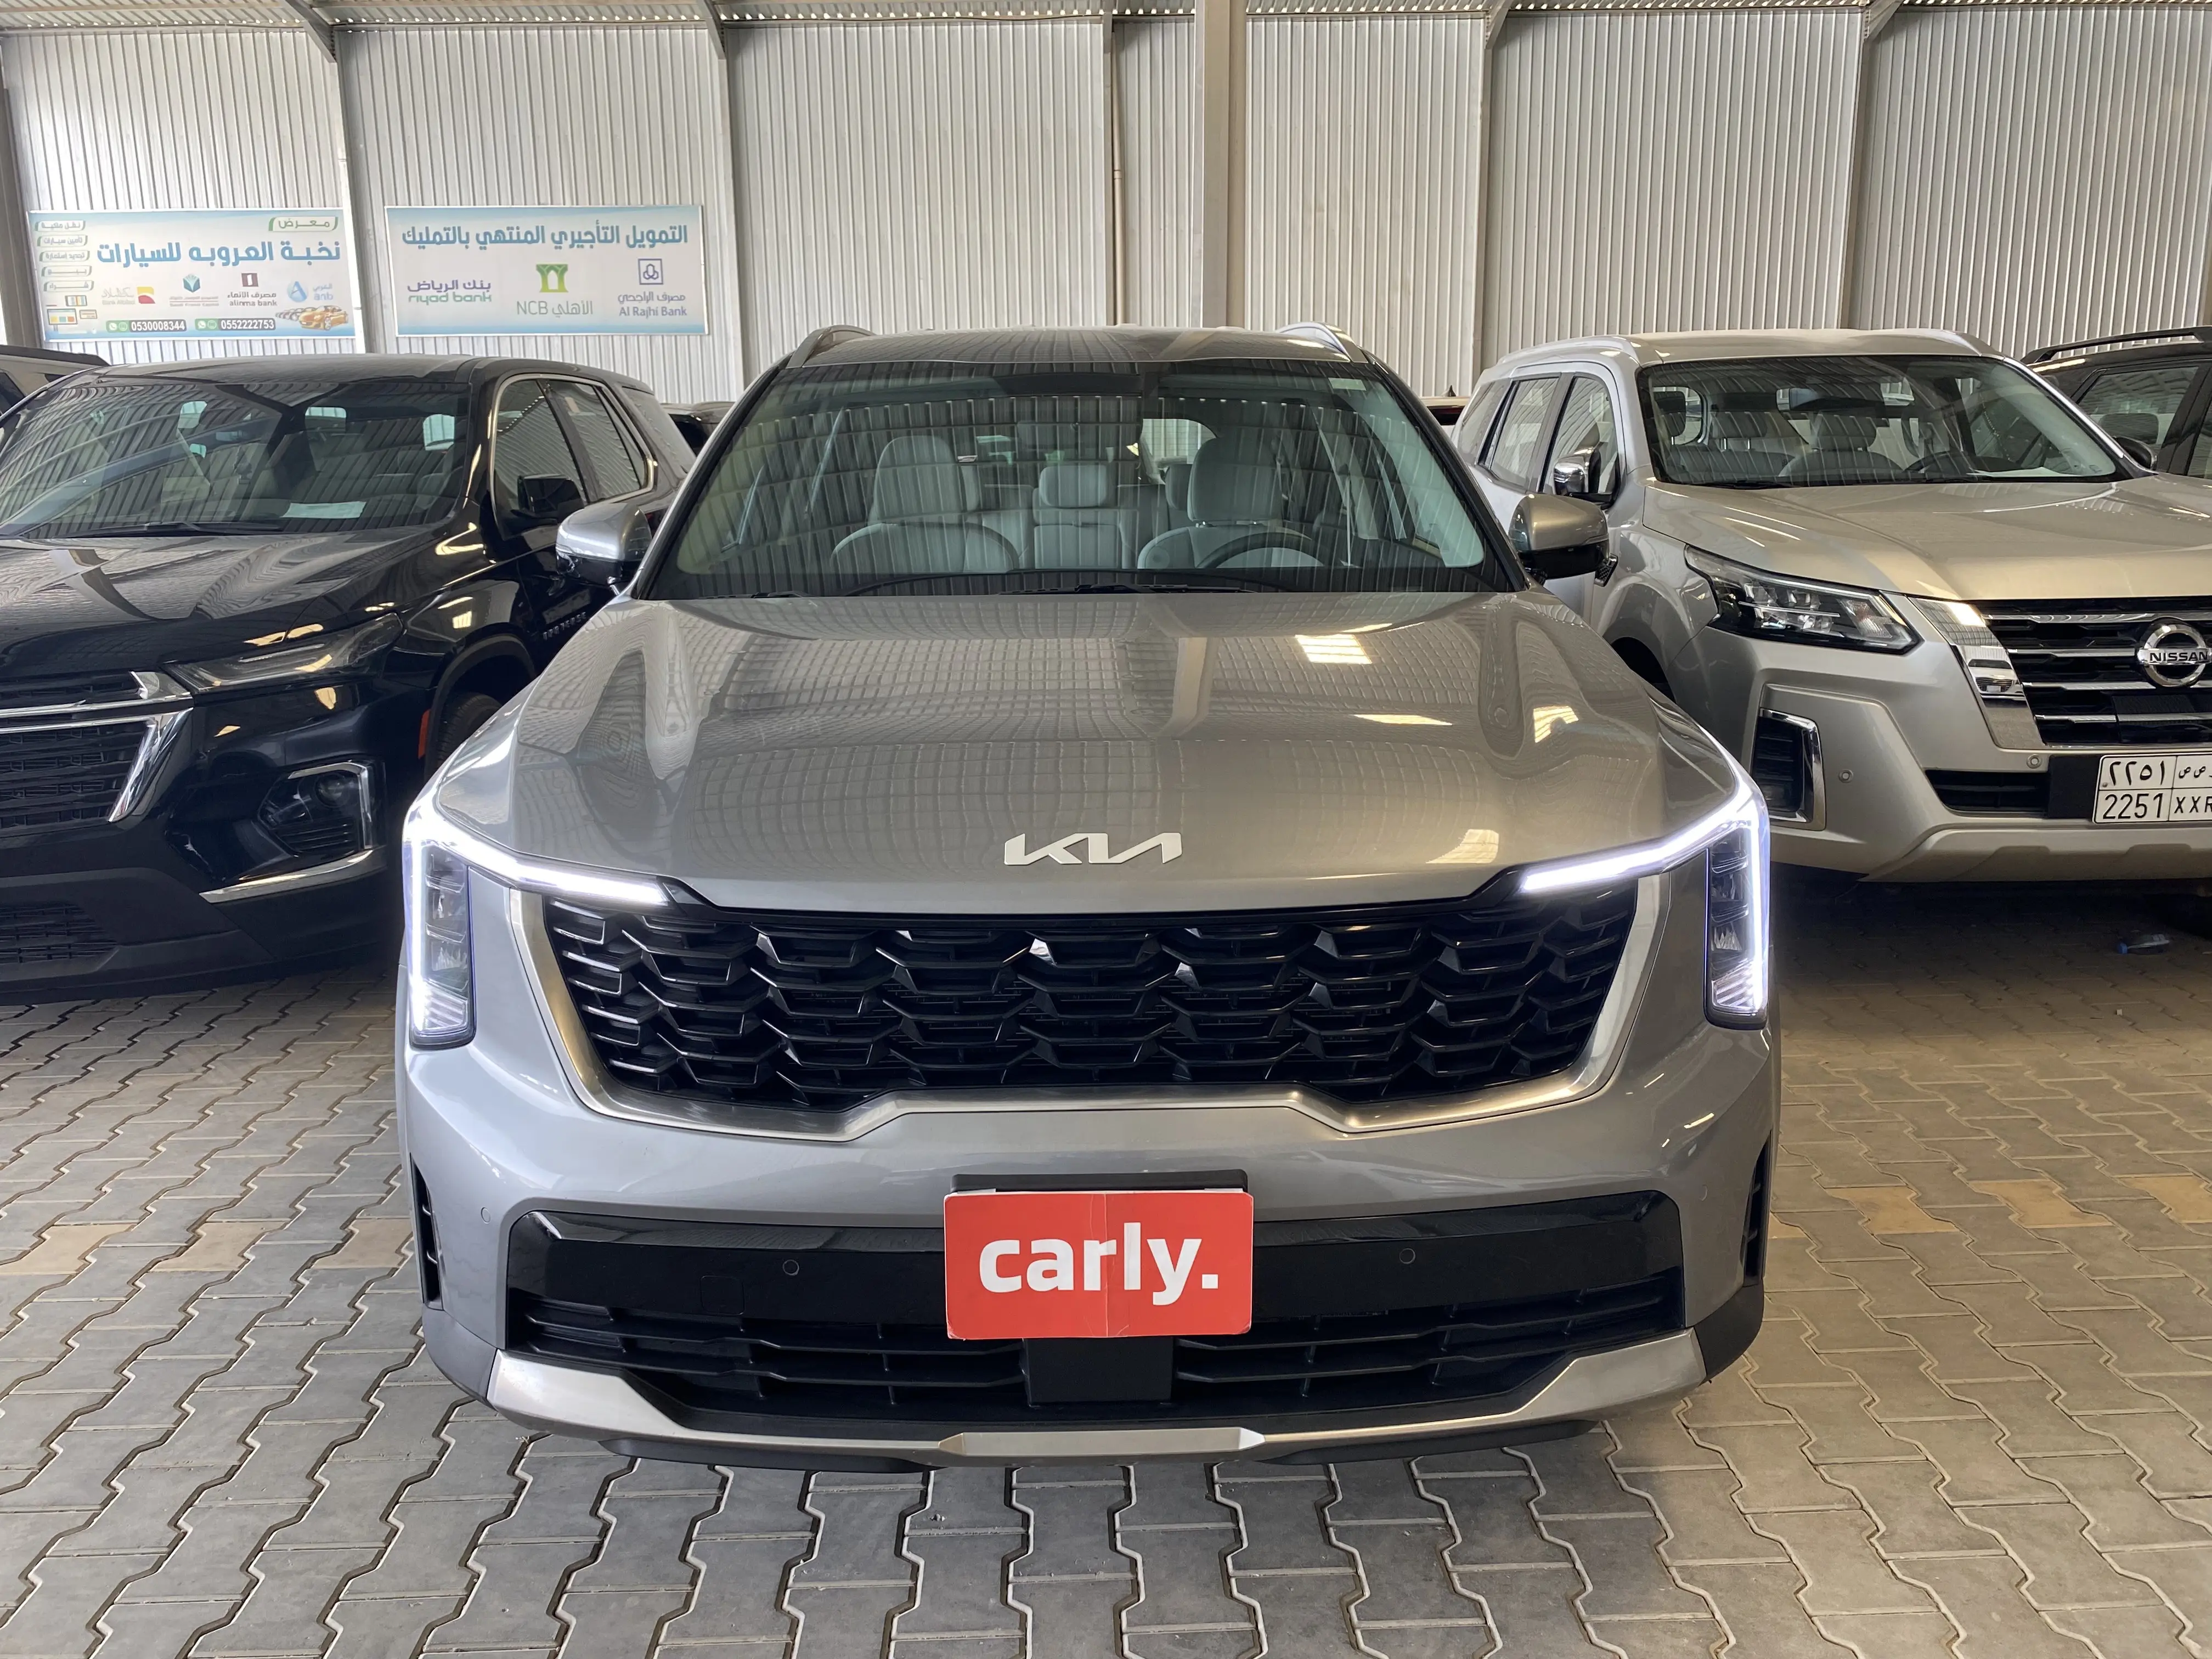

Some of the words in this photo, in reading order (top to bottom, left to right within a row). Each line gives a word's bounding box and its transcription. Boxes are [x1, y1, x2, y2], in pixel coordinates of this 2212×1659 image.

[278, 217, 330, 229] معرض
[402, 226, 470, 250] بالتمليك
[476, 225, 545, 250] المنتهي
[551, 219, 620, 250] التأجيري
[625, 224, 688, 249] التمويل
[97, 241, 181, 268] للسيارات
[280, 240, 341, 266] نخبة
[408, 279, 458, 292] الرياض
[463, 279, 491, 292] بنك
[313, 291, 334, 301] anb
[408, 292, 449, 306] riyad
[453, 291, 492, 302] bank
[618, 291, 654, 304] الراجحي
[656, 291, 686, 303] مصرف
[516, 300, 549, 315] NCB
[619, 306, 630, 317] Al
[633, 306, 658, 319] Rajhi
[661, 306, 687, 317] Bank
[131, 320, 185, 331] 0530008344
[221, 319, 274, 330] 0552222753
[2149, 651, 2209, 662] NISSAN
[2102, 792, 2163, 820] 2251
[979, 1221, 1219, 1306] carly.
